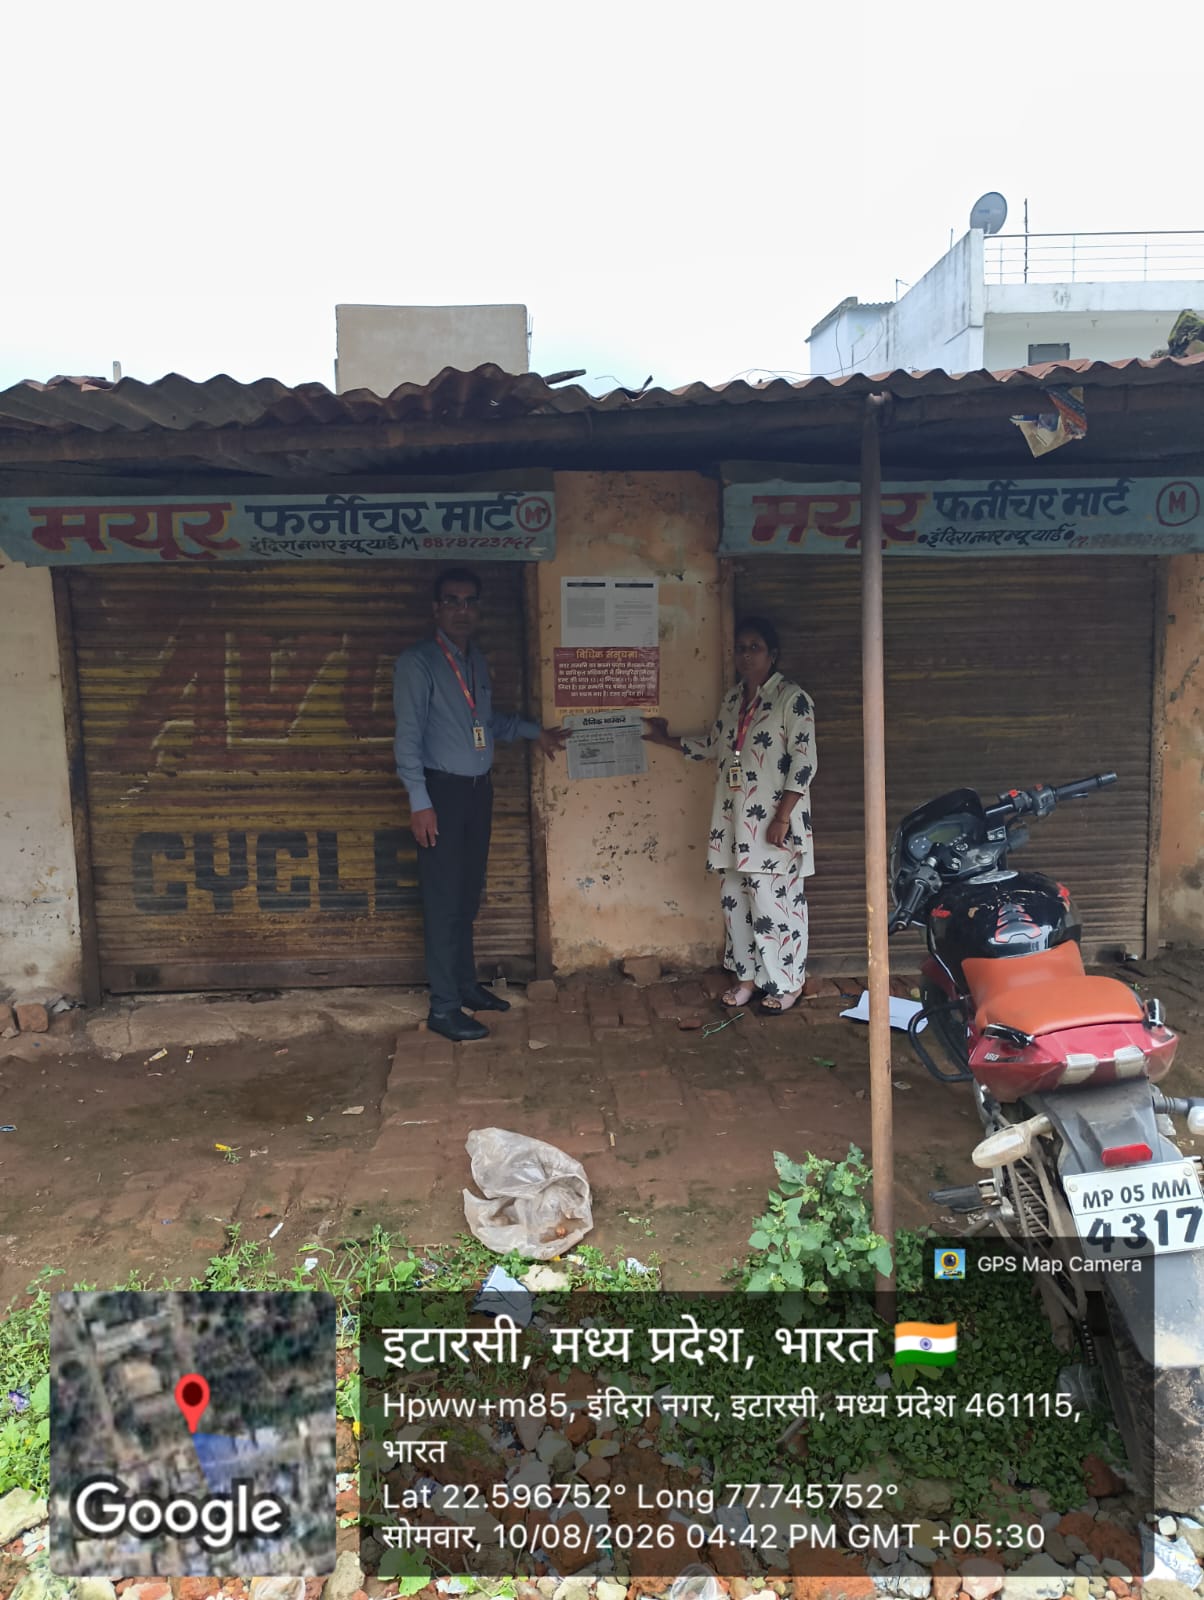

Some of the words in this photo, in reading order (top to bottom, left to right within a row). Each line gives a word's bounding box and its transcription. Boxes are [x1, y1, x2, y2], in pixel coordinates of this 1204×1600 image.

[28, 502, 241, 560] मयूर
[245, 494, 430, 536] फर्नीचर
[435, 491, 525, 532] मार्ट
[752, 492, 928, 549] मयूर
[1061, 477, 1136, 517] मार्ट
[575, 648, 604, 660] विधिक
[1083, 1189, 1113, 1209] MP
[1120, 1184, 1144, 1203] 05
[1152, 1178, 1191, 1200] MM
[1086, 1206, 1203, 1253] 4317
